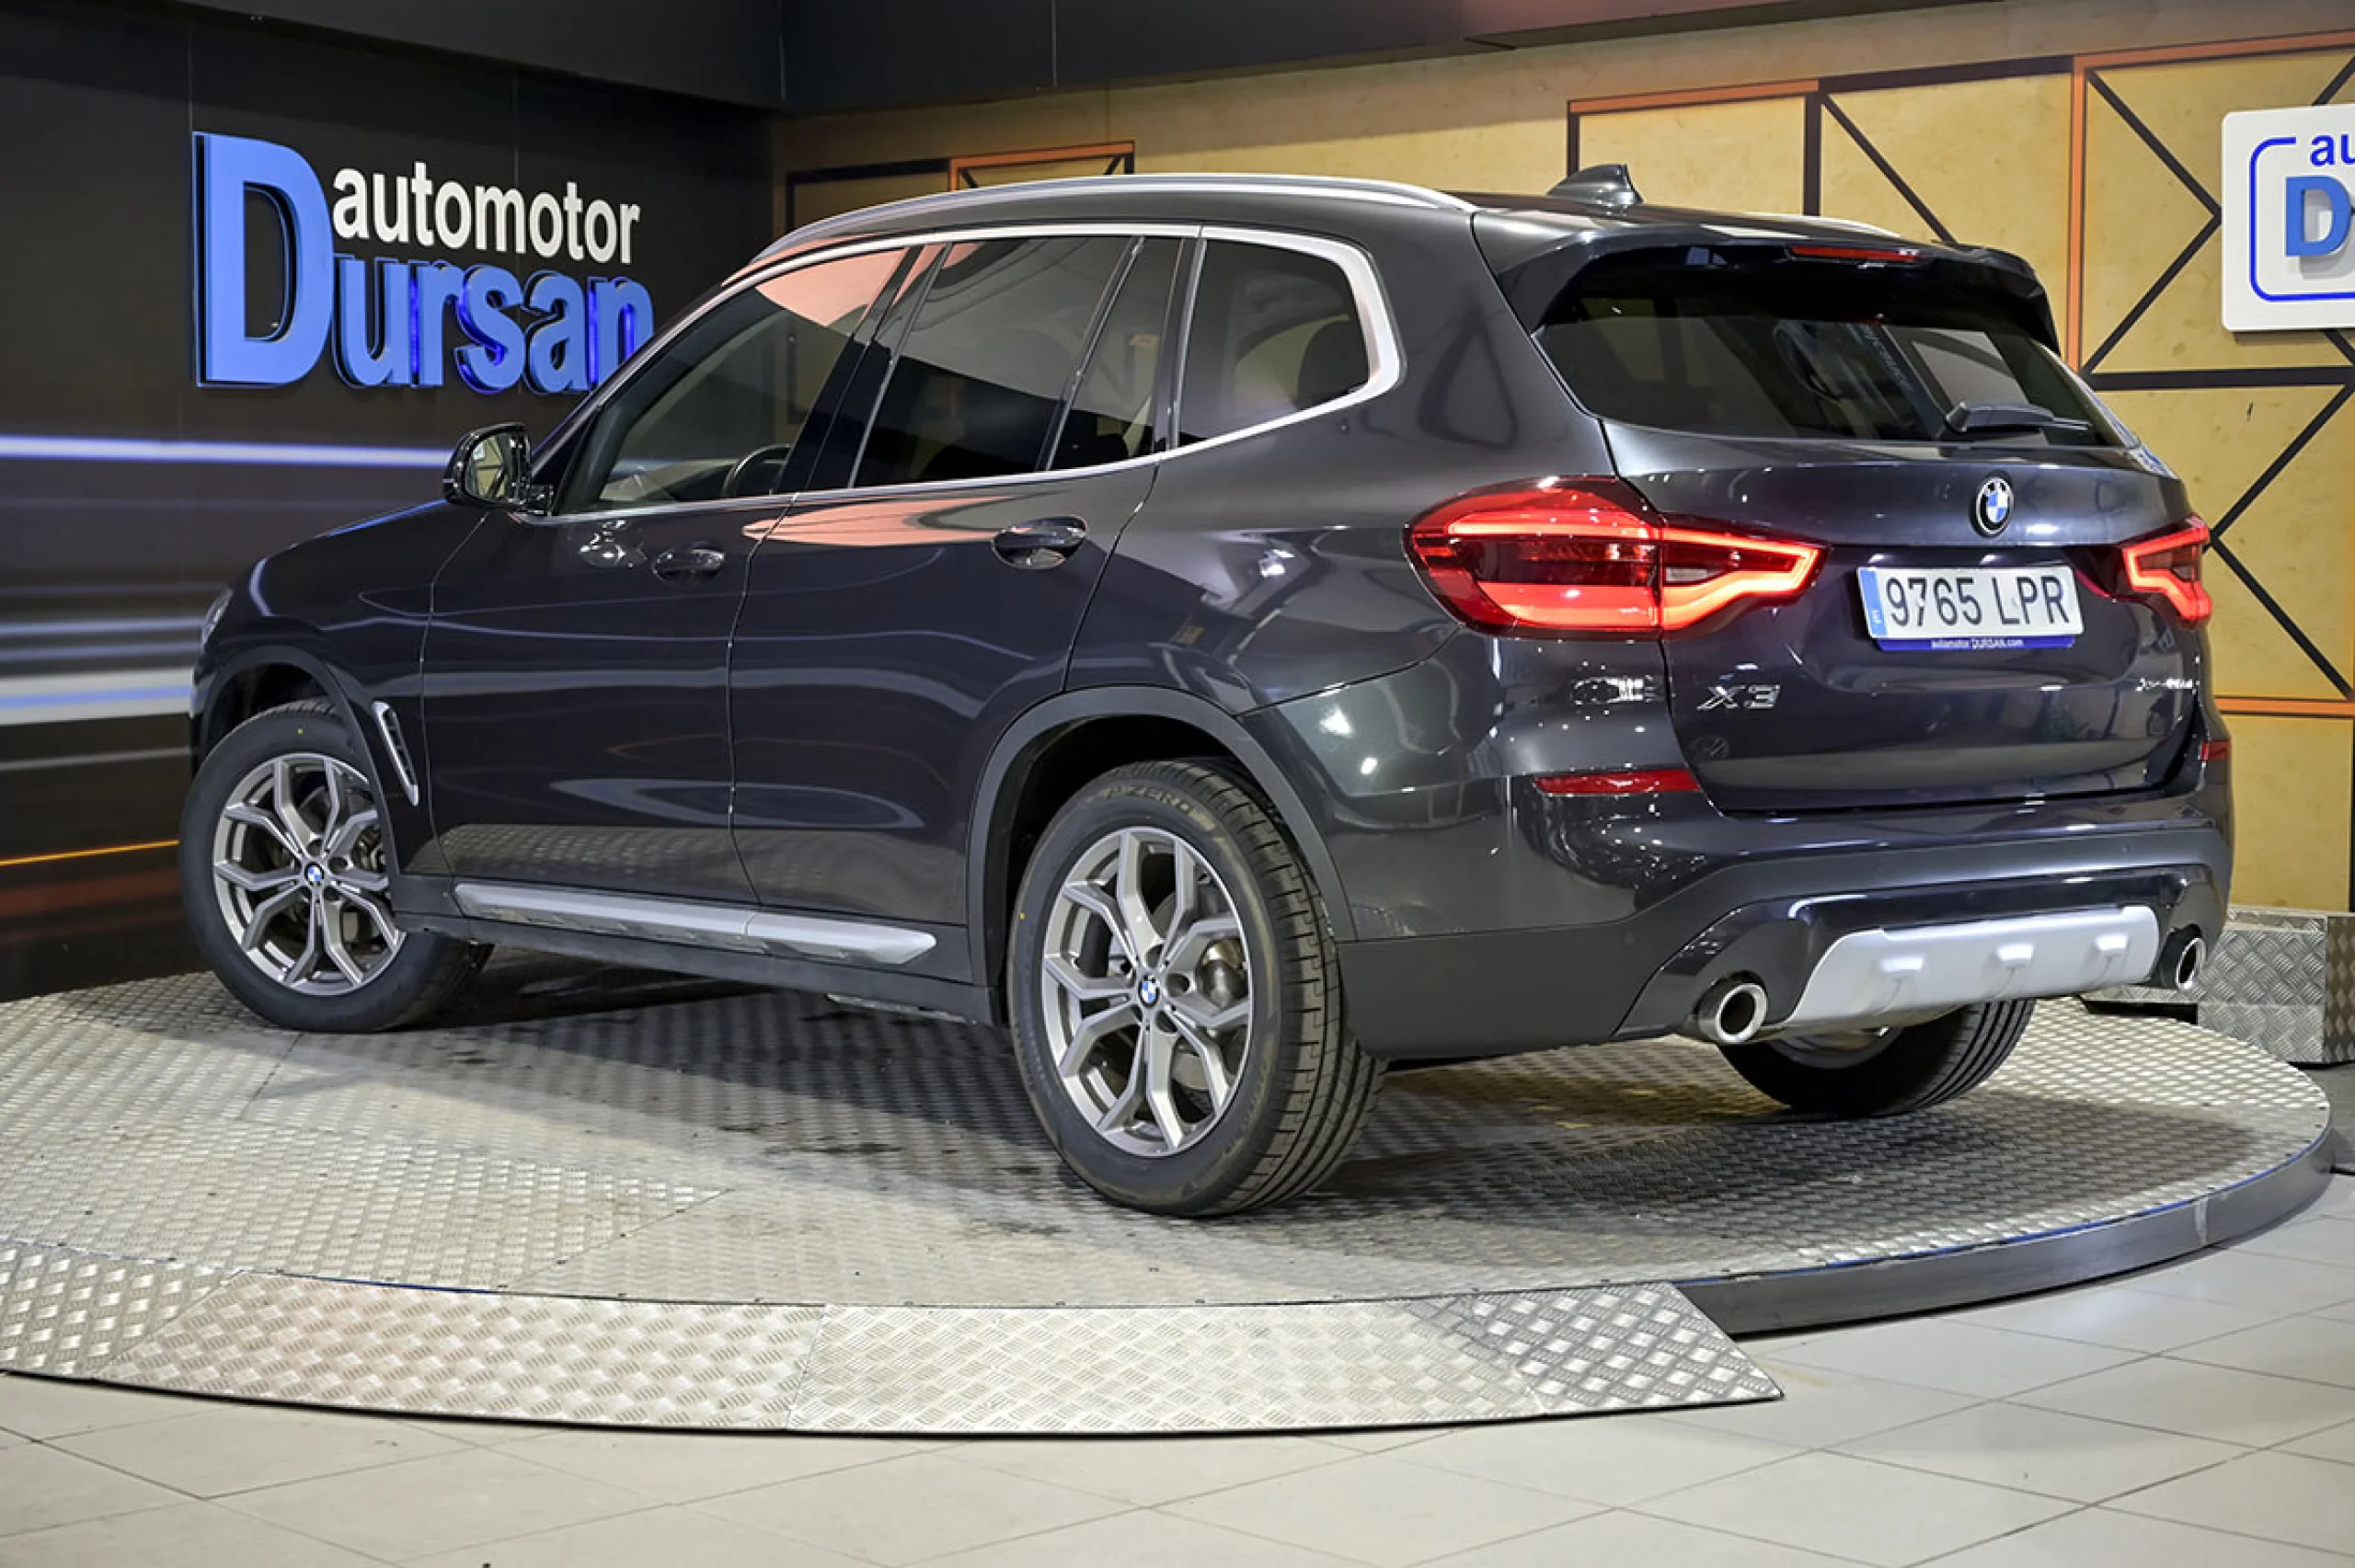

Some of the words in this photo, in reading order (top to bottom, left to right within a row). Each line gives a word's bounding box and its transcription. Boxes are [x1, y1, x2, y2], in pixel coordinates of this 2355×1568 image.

[332, 161, 641, 264] automotor
[192, 132, 654, 395] Dursan
[1886, 577, 1982, 627] 9765
[1991, 576, 2070, 625] LPR
[1696, 685, 1781, 711] X3
